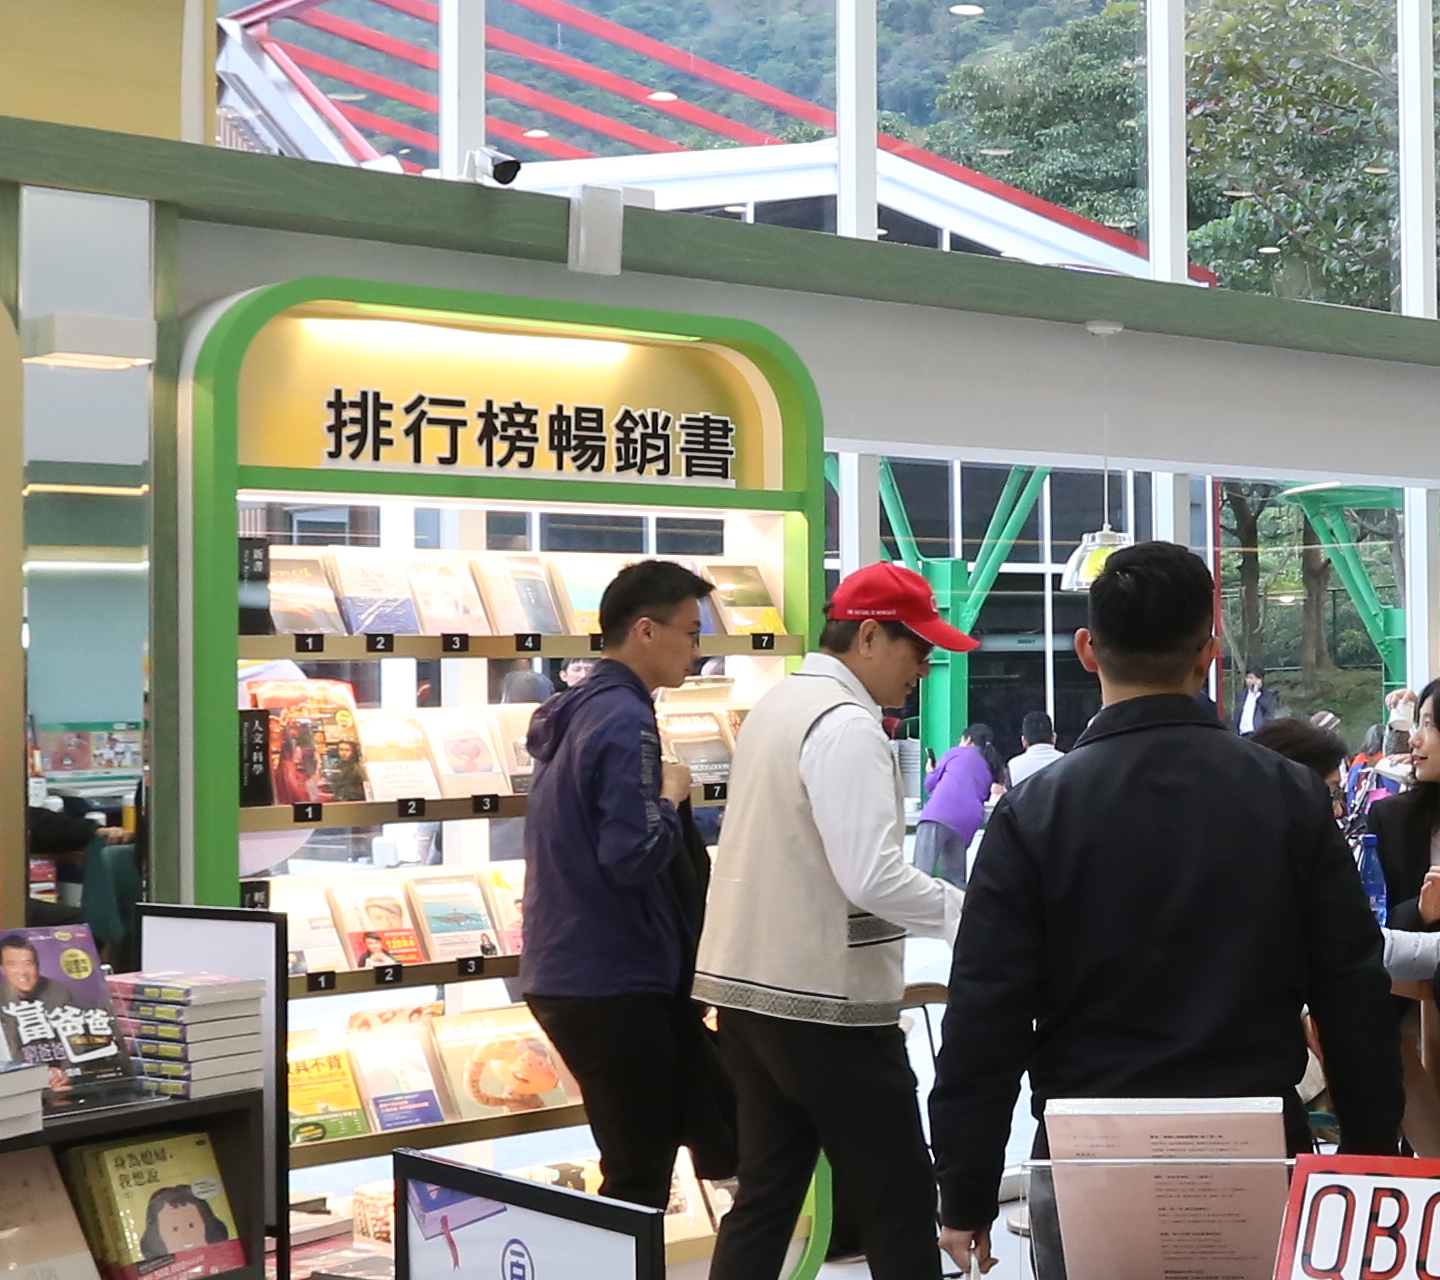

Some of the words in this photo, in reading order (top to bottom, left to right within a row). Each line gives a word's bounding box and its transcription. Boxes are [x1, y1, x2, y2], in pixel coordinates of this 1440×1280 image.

[324, 386, 736, 480] 排行榜暢銷書
[305, 637, 314, 649] 1
[375, 637, 385, 649] 2
[452, 637, 461, 649] 3
[524, 636, 534, 650] 4
[761, 635, 770, 648] 7
[712, 785, 721, 798] 7
[408, 800, 418, 814] 2
[482, 797, 492, 811] 3
[305, 806, 313, 819] 1
[466, 960, 477, 974] 3
[318, 975, 327, 989] 1
[384, 968, 395, 982] 2
[1, 1000, 119, 1064] 富爸爸
